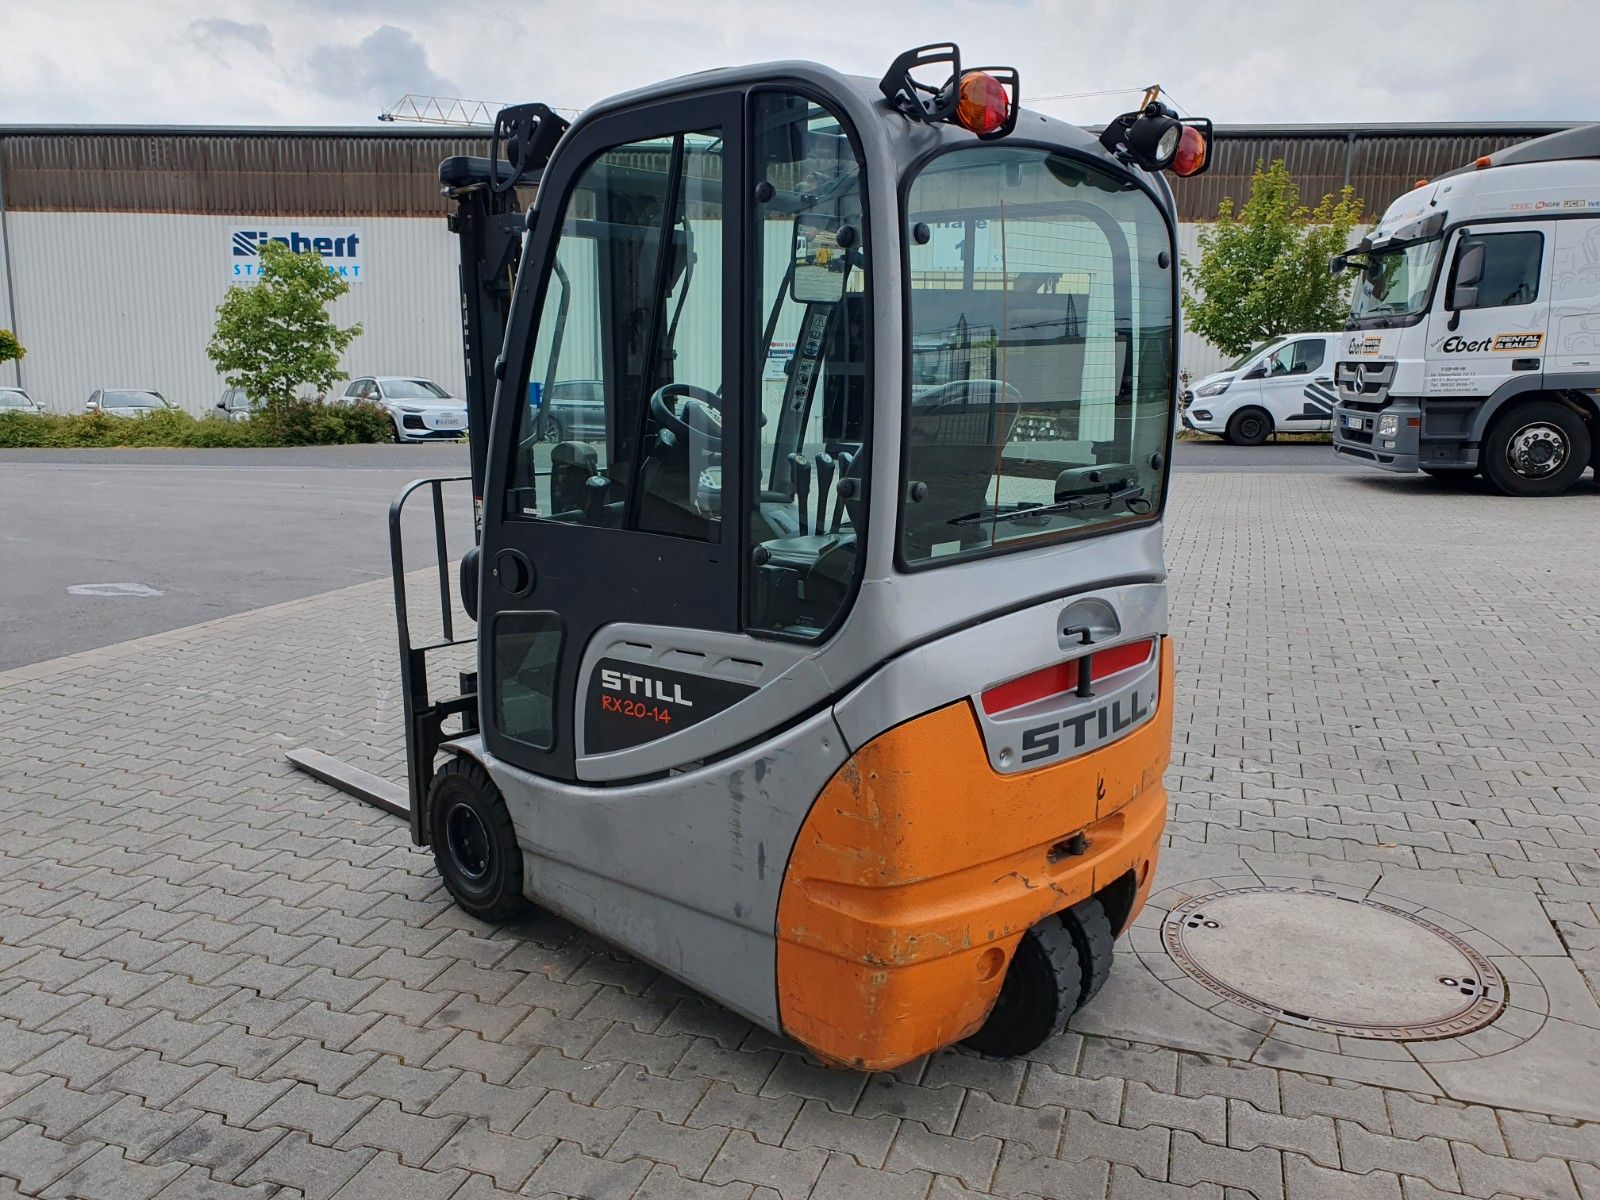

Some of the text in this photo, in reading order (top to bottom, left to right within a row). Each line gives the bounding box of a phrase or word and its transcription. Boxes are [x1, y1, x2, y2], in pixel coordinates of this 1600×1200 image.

[232, 232, 360, 257] Sibert
[233, 264, 361, 277] STARKT
[1442, 336, 1493, 353] Ebert
[602, 668, 693, 707] STILL
[602, 695, 671, 724] RX20-14
[1021, 691, 1148, 764] STILL
